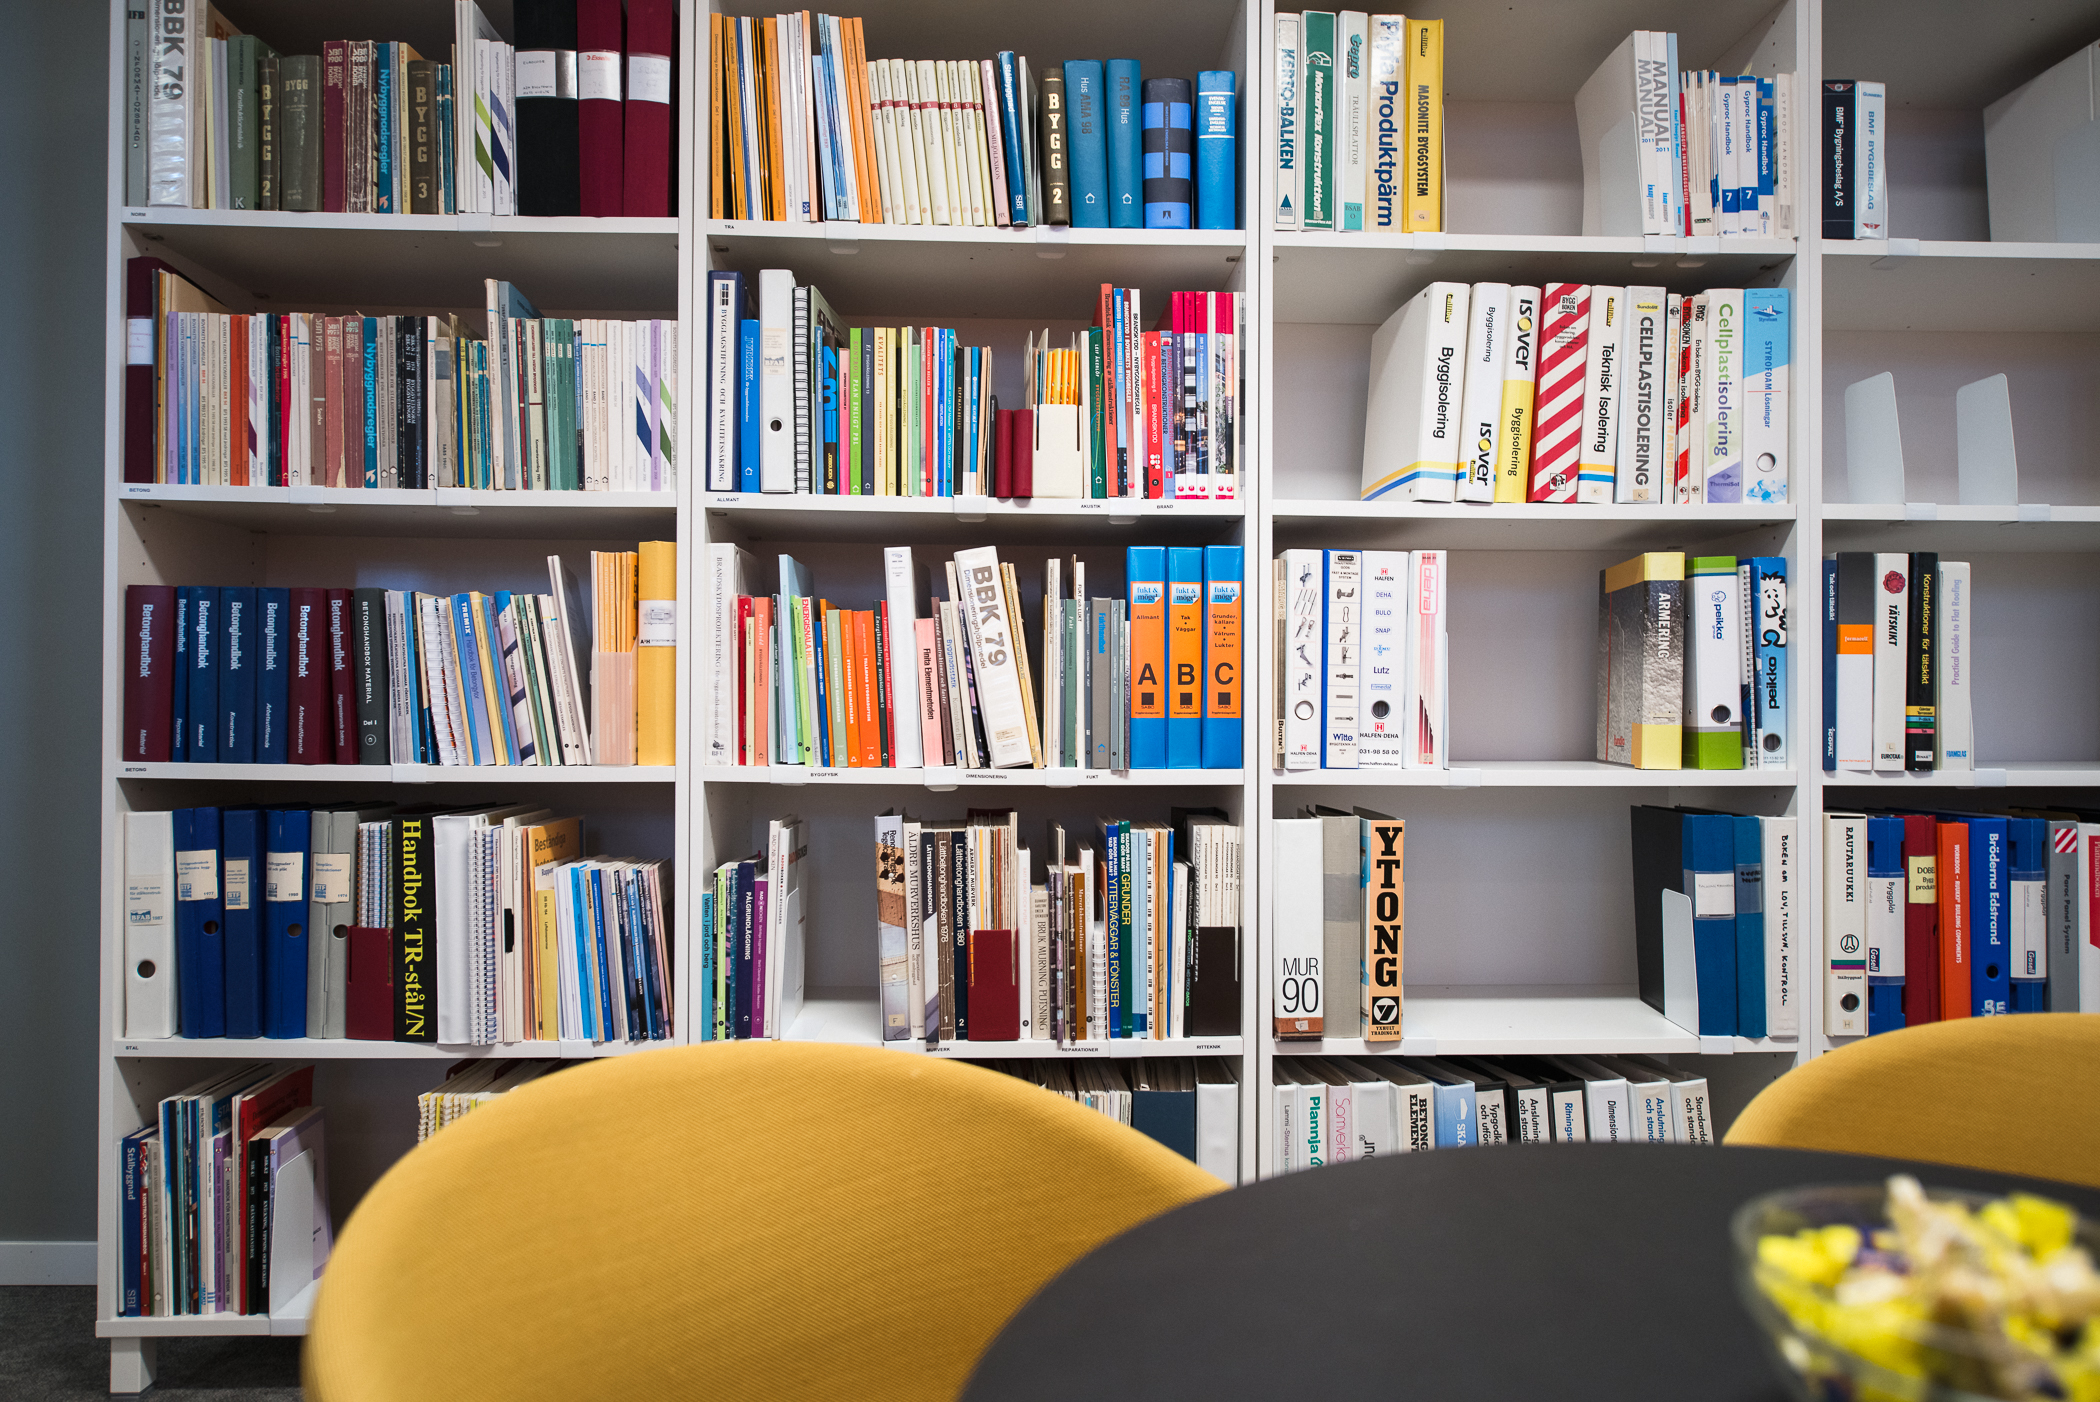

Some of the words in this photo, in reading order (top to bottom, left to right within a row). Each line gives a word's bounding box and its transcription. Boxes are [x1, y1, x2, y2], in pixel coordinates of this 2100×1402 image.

[163, 66, 184, 100] 79
[1004, 64, 1015, 112] Stålbyggnad
[1080, 77, 1090, 92] Hus
[1119, 77, 1129, 92] RA
[1119, 95, 1130, 107] 98
[1314, 70, 1323, 132] Monarflex
[1638, 59, 1653, 137] MANUAL
[1653, 60, 1669, 146] MANUAL
[1744, 91, 1752, 117] Gyproc
[262, 85, 272, 161] BYGG
[378, 69, 389, 174] Nybyggnadsregler
[415, 87, 427, 162] BYGG
[1080, 94, 1091, 118] AMA
[1081, 121, 1092, 134] 98
[1121, 108, 1130, 124] Hus
[1280, 48, 1295, 169] KERTO-BALKEN
[1417, 85, 1429, 133] MASONITE
[1760, 111, 1768, 139] Gyproc
[1048, 94, 1061, 169] BYGG
[1374, 80, 1398, 227] Produktpärm
[1314, 134, 1322, 211] Konstruktion
[1417, 137, 1428, 196] BYGGSYSTEM
[1834, 129, 1843, 189] Bygningsbeslag
[263, 181, 271, 196] 2
[418, 183, 427, 198] 3
[1015, 195, 1023, 209] SBI
[1053, 188, 1062, 204] 2
[1726, 193, 1732, 201] 7
[1746, 191, 1752, 199] 7
[1834, 191, 1843, 206] A/S
[1484, 307, 1495, 362] Byggisolering
[1600, 343, 1614, 391] Teknisk
[1714, 303, 1733, 456] Cellplastisolering
[1764, 341, 1772, 390] STYROFOAM
[365, 343, 376, 448] Nybyggnadsregler
[1433, 347, 1454, 439] Byggisolering
[1635, 316, 1653, 486] CELLPLASTISOLERING
[1666, 398, 1675, 421] isoler
[1508, 408, 1523, 476] Byggisolering
[1594, 397, 1611, 453] Isolering
[1665, 426, 1675, 485] HANDBOK
[972, 565, 1000, 626] BBK
[1423, 568, 1434, 611] deha
[1922, 574, 1931, 635] Konstruktioner
[1952, 579, 1962, 606] Roofing
[177, 599, 187, 652] Betonghandbok
[197, 601, 210, 668] Betonghandbok
[229, 602, 242, 670] Betonghandbok
[265, 603, 278, 670] Betonghandbok
[362, 602, 371, 666] BETONGHANDBOK
[462, 602, 471, 635] TREMIX
[963, 570, 987, 669] Dimensioneringshjälpmedel
[1098, 613, 1106, 654] Fukthandbok
[1658, 593, 1670, 658] ARMERING
[1714, 604, 1723, 639] peikko
[1888, 605, 1900, 646] TÄTSKIKT
[1952, 608, 1961, 622] Flat
[139, 604, 153, 677] Betonghandbok
[298, 606, 310, 677] Betonghandbok
[466, 640, 474, 661] Handbok
[924, 648, 932, 665] Finita
[985, 632, 1007, 666] 79
[1922, 639, 1930, 650] för
[1952, 634, 1961, 654] Guide
[364, 668, 372, 704] MATERIAL
[470, 672, 480, 699] Betongytor
[1138, 663, 1157, 685] A
[1178, 663, 1195, 685] B
[1215, 662, 1234, 686] C
[1769, 657, 1777, 709] peikko
[1921, 654, 1929, 684] tätskikt
[1951, 657, 1960, 685] Practical
[924, 667, 935, 720] Elementmetoden
[139, 729, 147, 754] Material
[534, 839, 566, 851] Beständiga
[908, 831, 918, 867] ÄLDRE
[1989, 833, 1999, 889] Bröderna
[402, 820, 422, 922] Handbok
[938, 840, 949, 924] Lättbetonghandboken
[955, 844, 964, 927] Lättbetonghandboken
[910, 870, 920, 950] MURVERKSHUS
[1109, 878, 1119, 950] YTTERVÄGGAR
[1121, 874, 1131, 925] GRUNDER
[1374, 827, 1402, 987] YTONG
[1888, 882, 1896, 913] Byggplåt
[1989, 892, 2000, 945] Edstrand
[744, 892, 752, 960] PÅLGRUNDLÄGGNING
[940, 925, 949, 942] 1978
[957, 929, 965, 946] 1980
[1037, 921, 1046, 944] BRUK
[2063, 925, 2071, 954] System
[404, 928, 425, 1036] TR-stål/N
[702, 951, 710, 968] berg
[1038, 946, 1048, 987] MURNING
[1283, 958, 1318, 975] MUR
[1870, 948, 1879, 971] Gasell
[2027, 952, 2035, 974] Gasell
[1111, 960, 1120, 1007] FÖNSTER
[1283, 978, 1318, 1013] 90
[1038, 989, 1048, 1030] PUTSNING
[1308, 1096, 1321, 1153] Plannja
[1419, 1098, 1428, 1150] BETONG
[128, 1147, 136, 1200] Stålbyggnad
[128, 1290, 136, 1307] SBI
